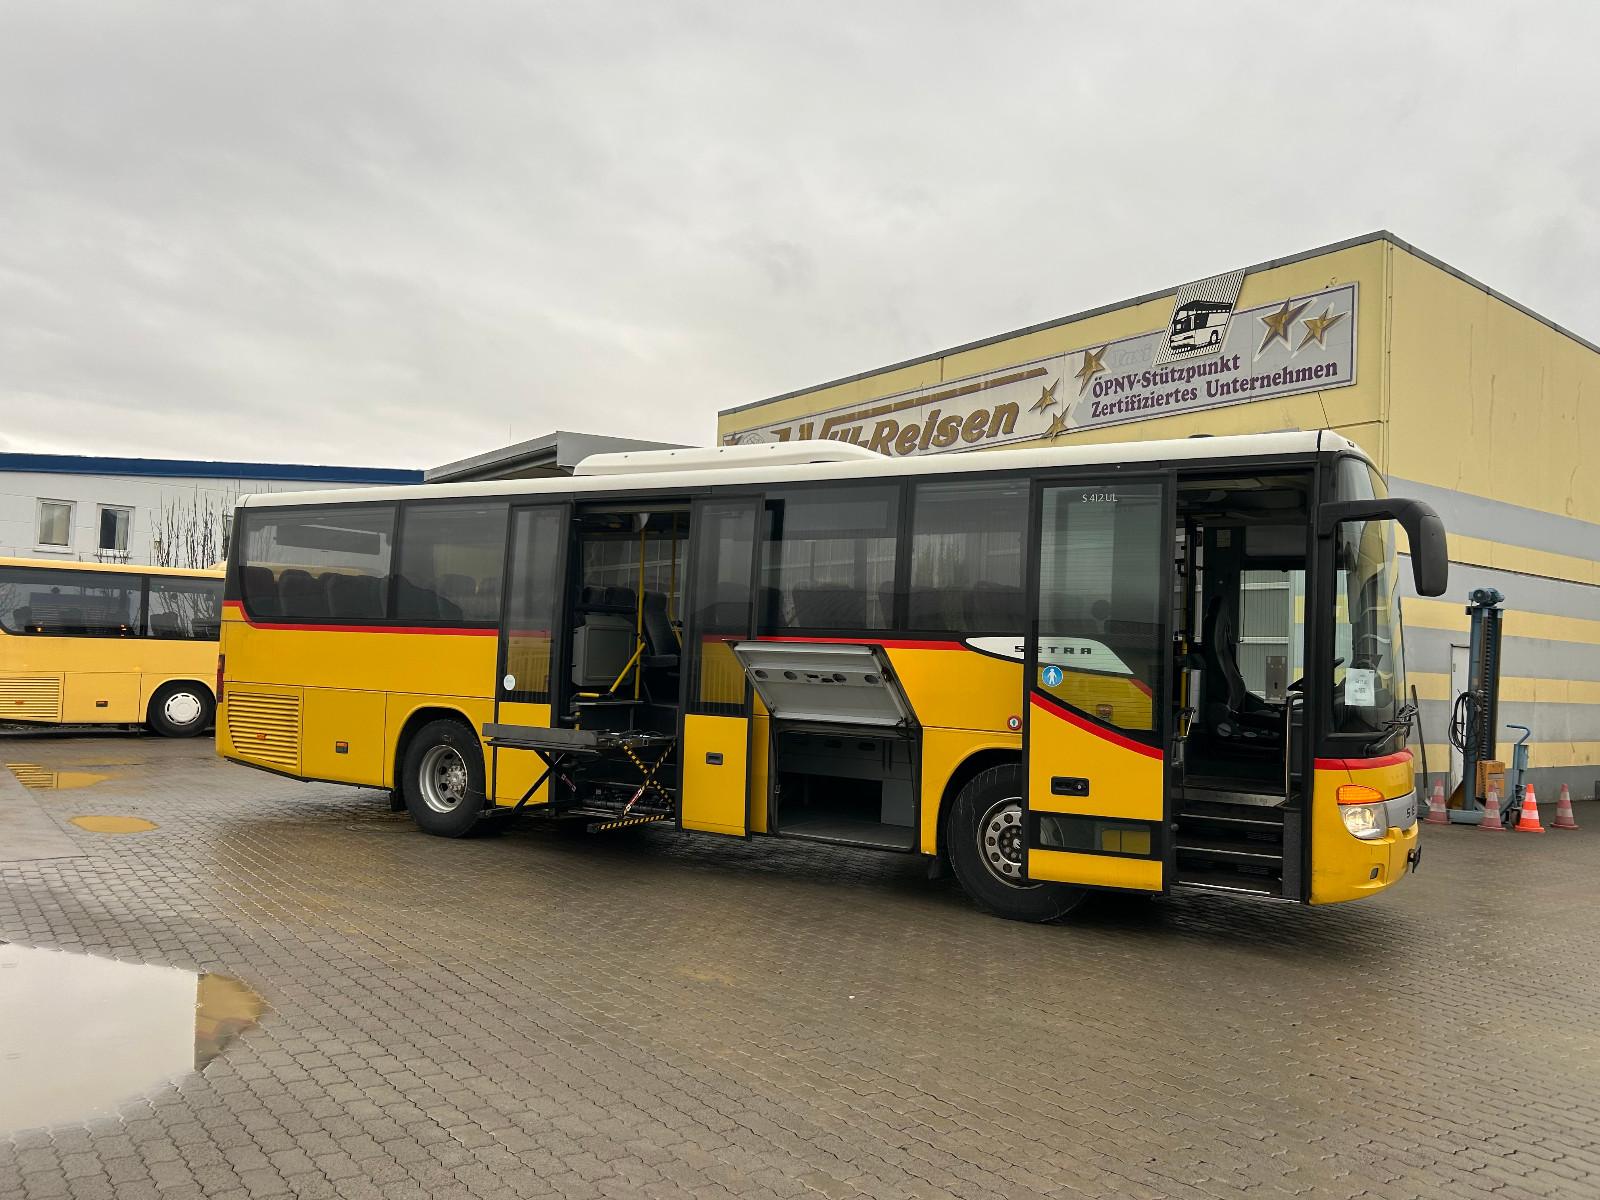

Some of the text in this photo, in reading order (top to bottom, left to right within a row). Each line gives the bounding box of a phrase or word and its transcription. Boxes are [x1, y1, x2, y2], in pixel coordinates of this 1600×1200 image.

[1091, 361, 1338, 418] Zertifiziertes Unternehmen
[1092, 353, 1241, 399] ÖPNV-Stützpunkt
[1082, 493, 1088, 503] S
